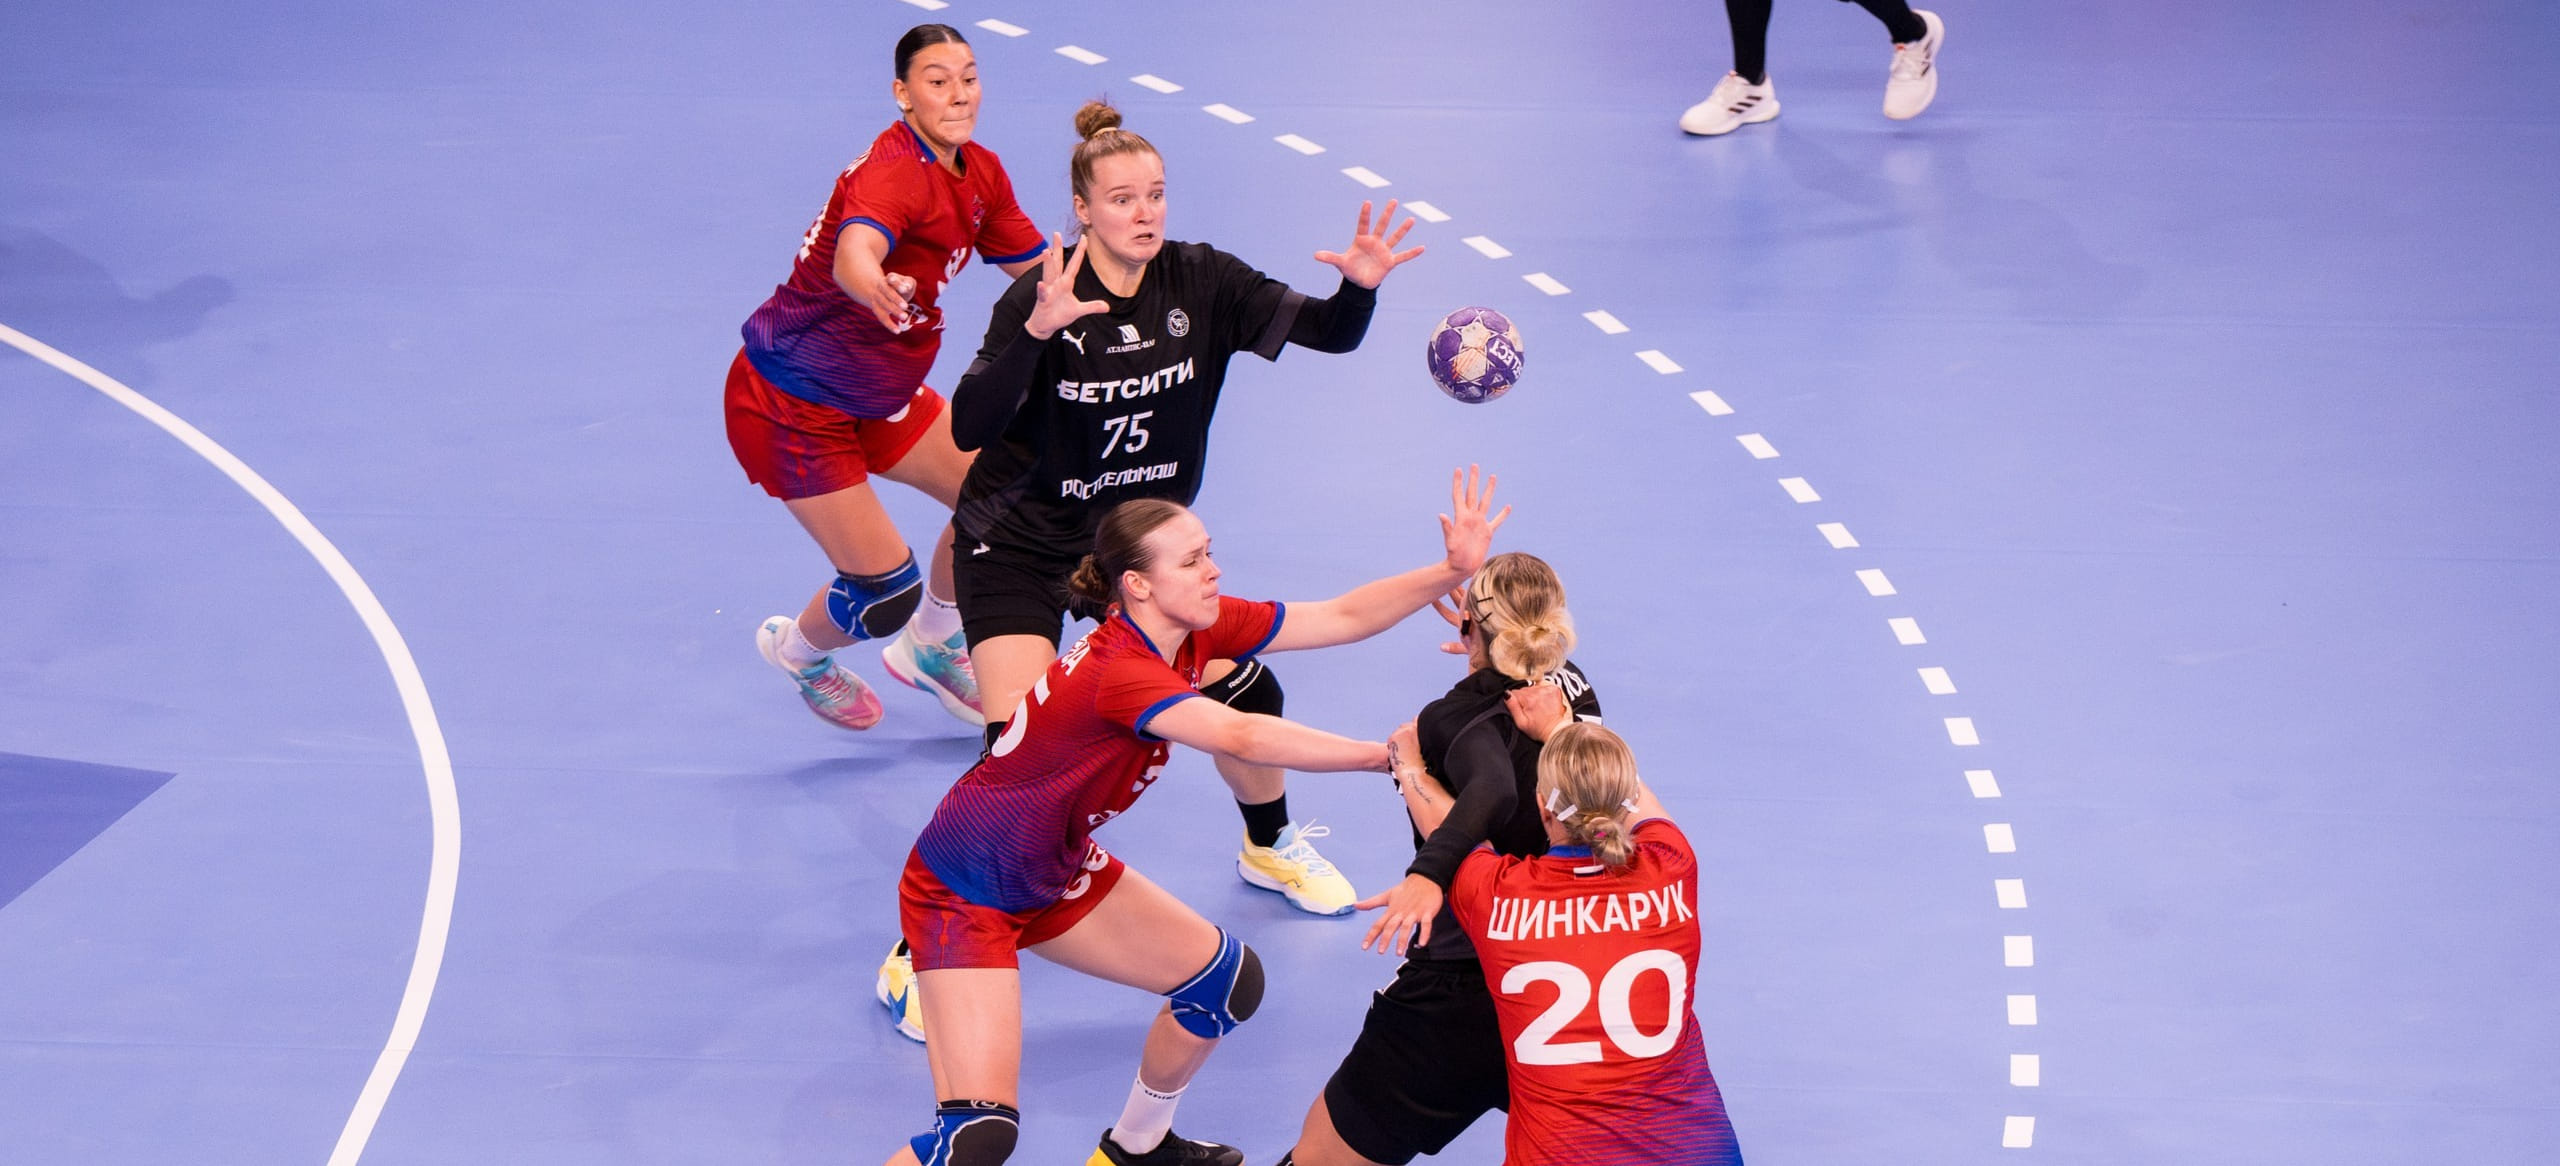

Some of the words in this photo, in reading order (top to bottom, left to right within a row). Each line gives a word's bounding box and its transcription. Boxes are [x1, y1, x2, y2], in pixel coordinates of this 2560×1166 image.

[1056, 356, 1195, 404] БЕТСИТИ
[1101, 409, 1154, 460] 75
[1486, 879, 1693, 941] ШИНКАРУК
[1500, 948, 1688, 1066] 20
